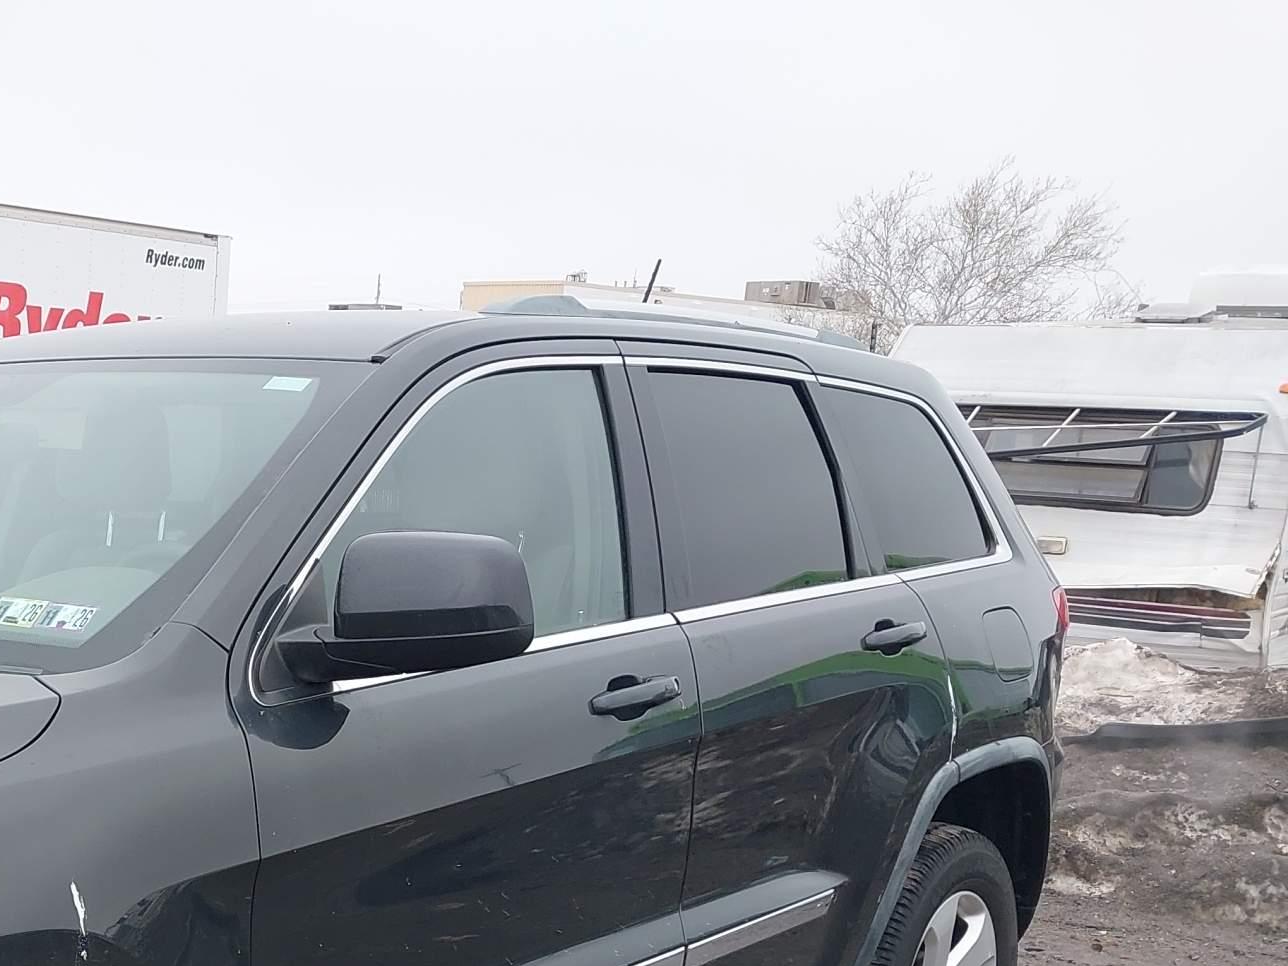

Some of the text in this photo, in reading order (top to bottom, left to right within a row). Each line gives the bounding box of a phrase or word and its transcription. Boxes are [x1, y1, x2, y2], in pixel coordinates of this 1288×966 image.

[145, 248, 205, 270] Ryder.com
[22, 603, 44, 623] 26
[72, 608, 94, 628] 26
